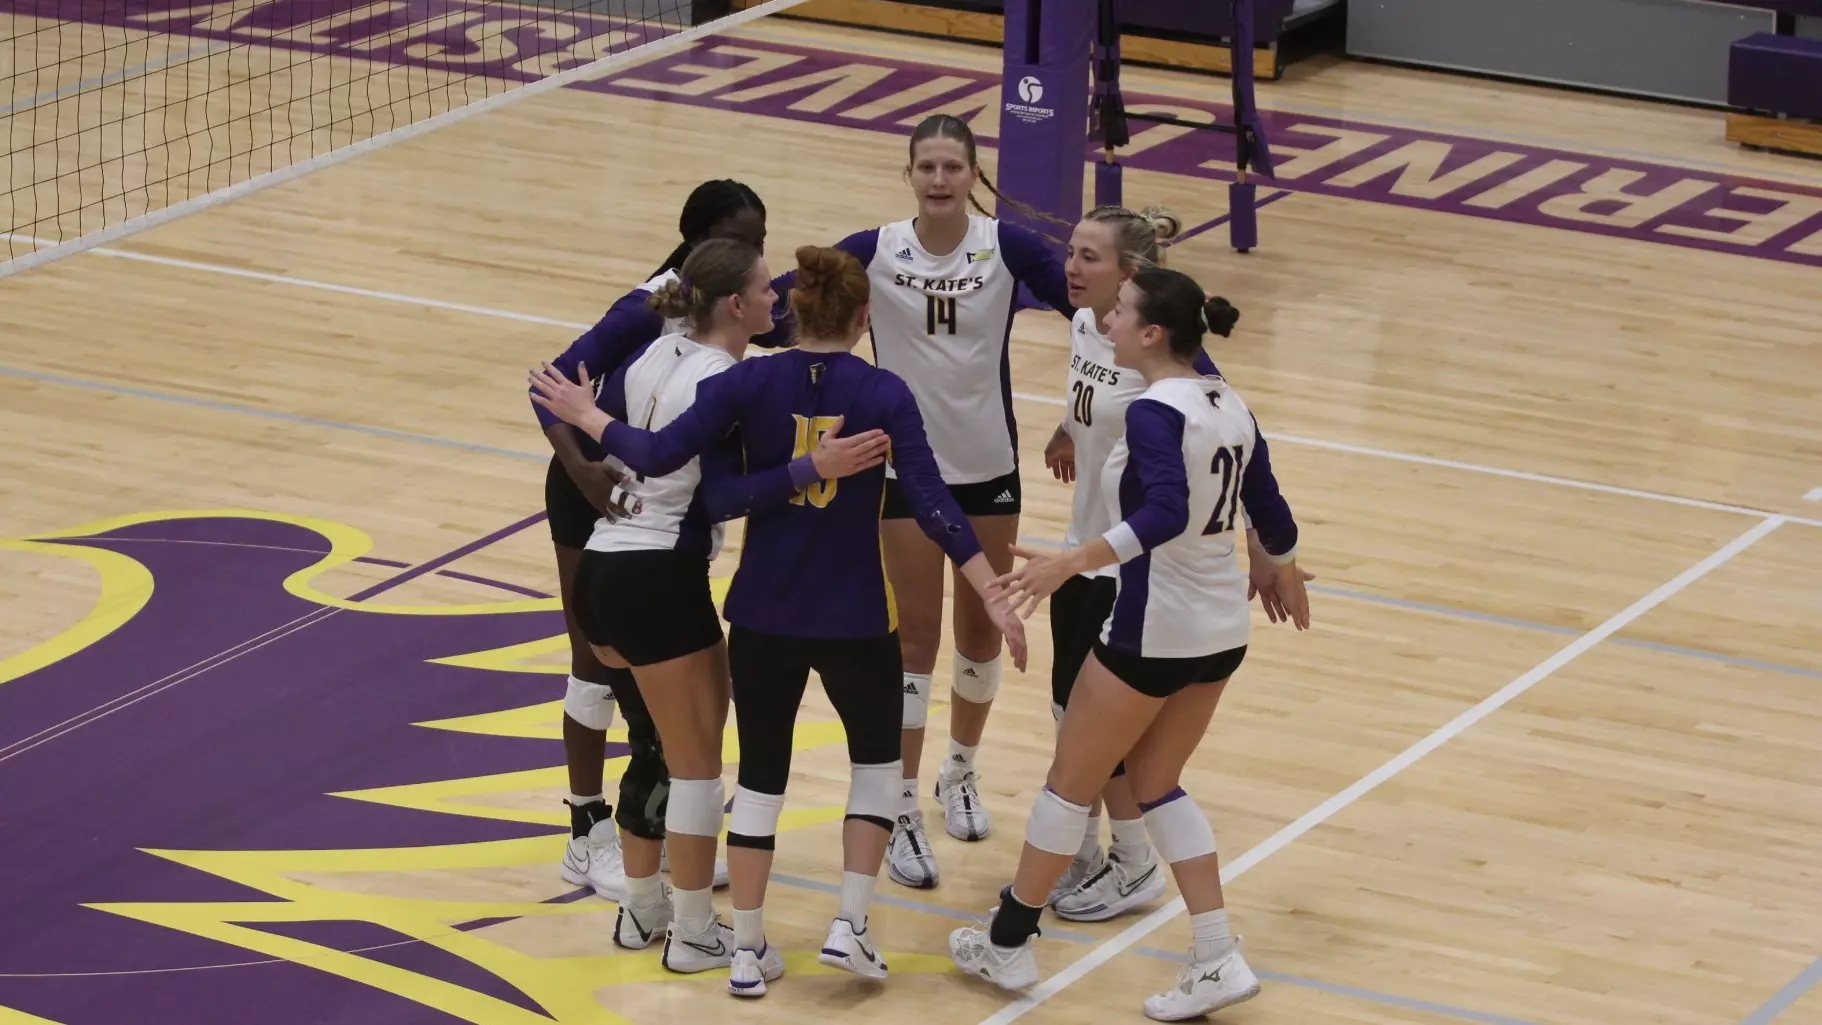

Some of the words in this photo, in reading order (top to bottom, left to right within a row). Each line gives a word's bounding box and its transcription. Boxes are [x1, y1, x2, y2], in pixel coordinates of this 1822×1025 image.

[1005, 103, 1028, 112] SPORTS
[1028, 106, 1054, 117] IMPORTS
[895, 253, 914, 261] adidas
[895, 274, 917, 289] ST.
[923, 275, 984, 291] KATE'S
[926, 295, 957, 335] 14
[1071, 354, 1082, 371] ST.
[1080, 360, 1120, 386] KATE'S
[1072, 380, 1094, 428] 20
[1200, 445, 1244, 536] 21
